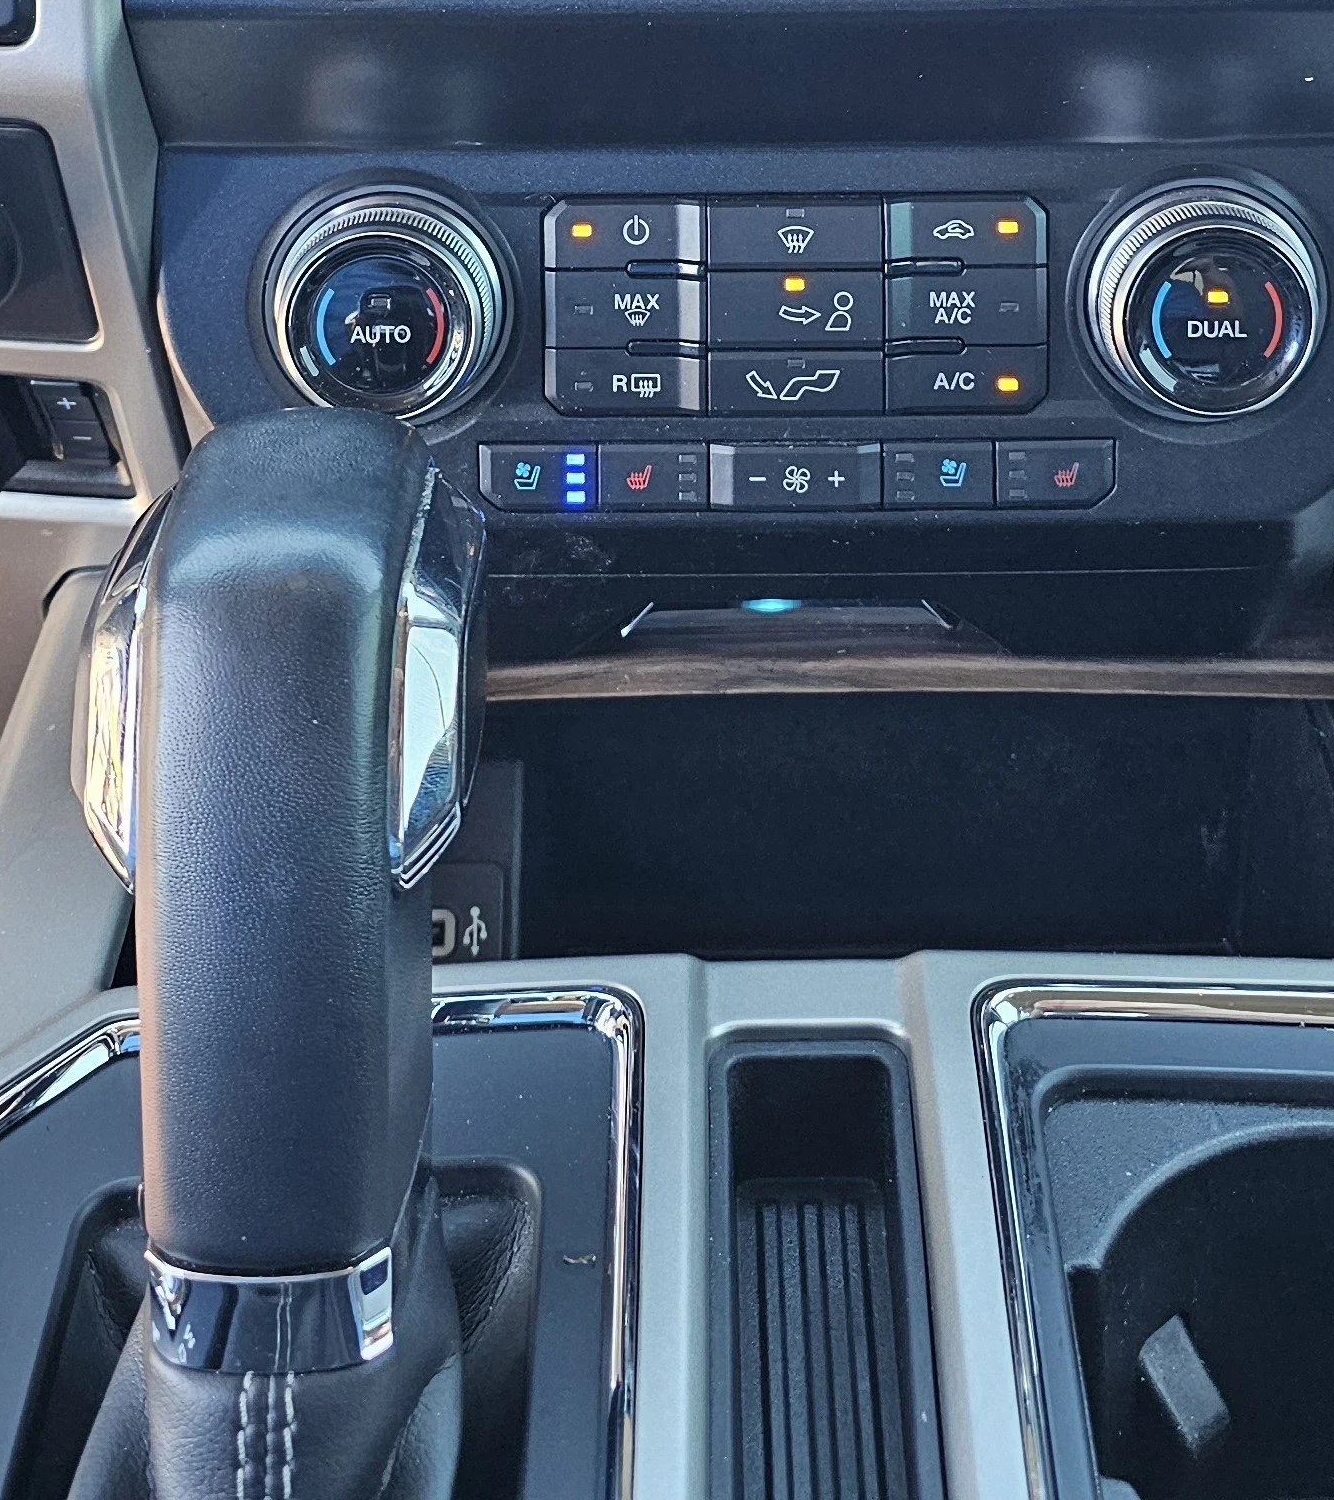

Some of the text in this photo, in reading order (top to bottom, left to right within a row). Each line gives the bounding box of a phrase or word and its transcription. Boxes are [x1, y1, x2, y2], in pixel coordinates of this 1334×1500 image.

[614, 293, 660, 310] MAX
[929, 291, 976, 308] MAX
[934, 308, 972, 325] A/C
[350, 325, 411, 345] AUTO
[1187, 320, 1247, 339] DUAL
[612, 375, 627, 393] R
[933, 372, 975, 392] A/C
